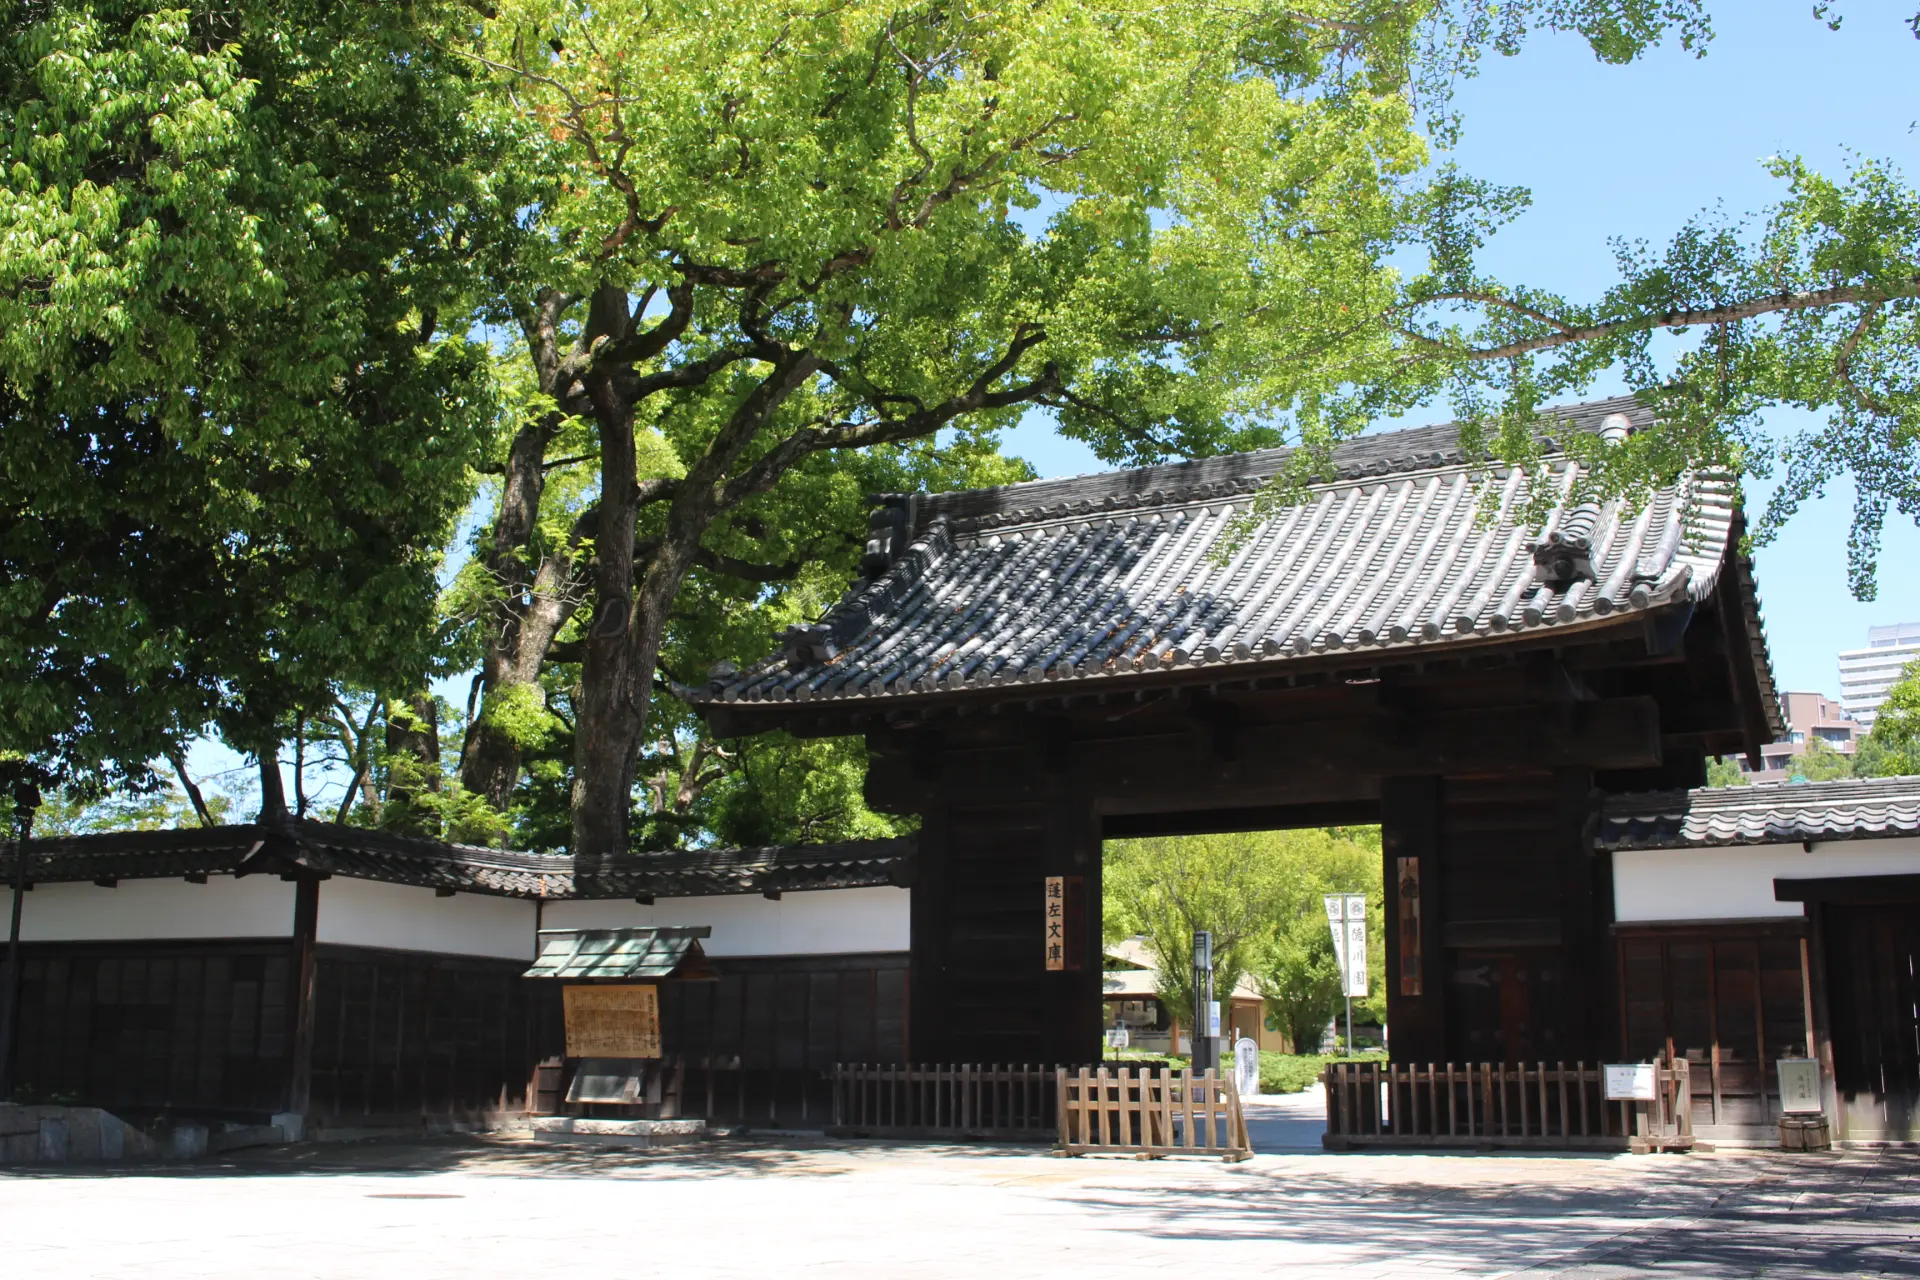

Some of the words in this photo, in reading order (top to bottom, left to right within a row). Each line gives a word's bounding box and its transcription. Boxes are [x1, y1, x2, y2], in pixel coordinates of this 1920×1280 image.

[1048, 882, 1062, 962] 蓬左文庫
[1351, 927, 1365, 986] 徳川園
